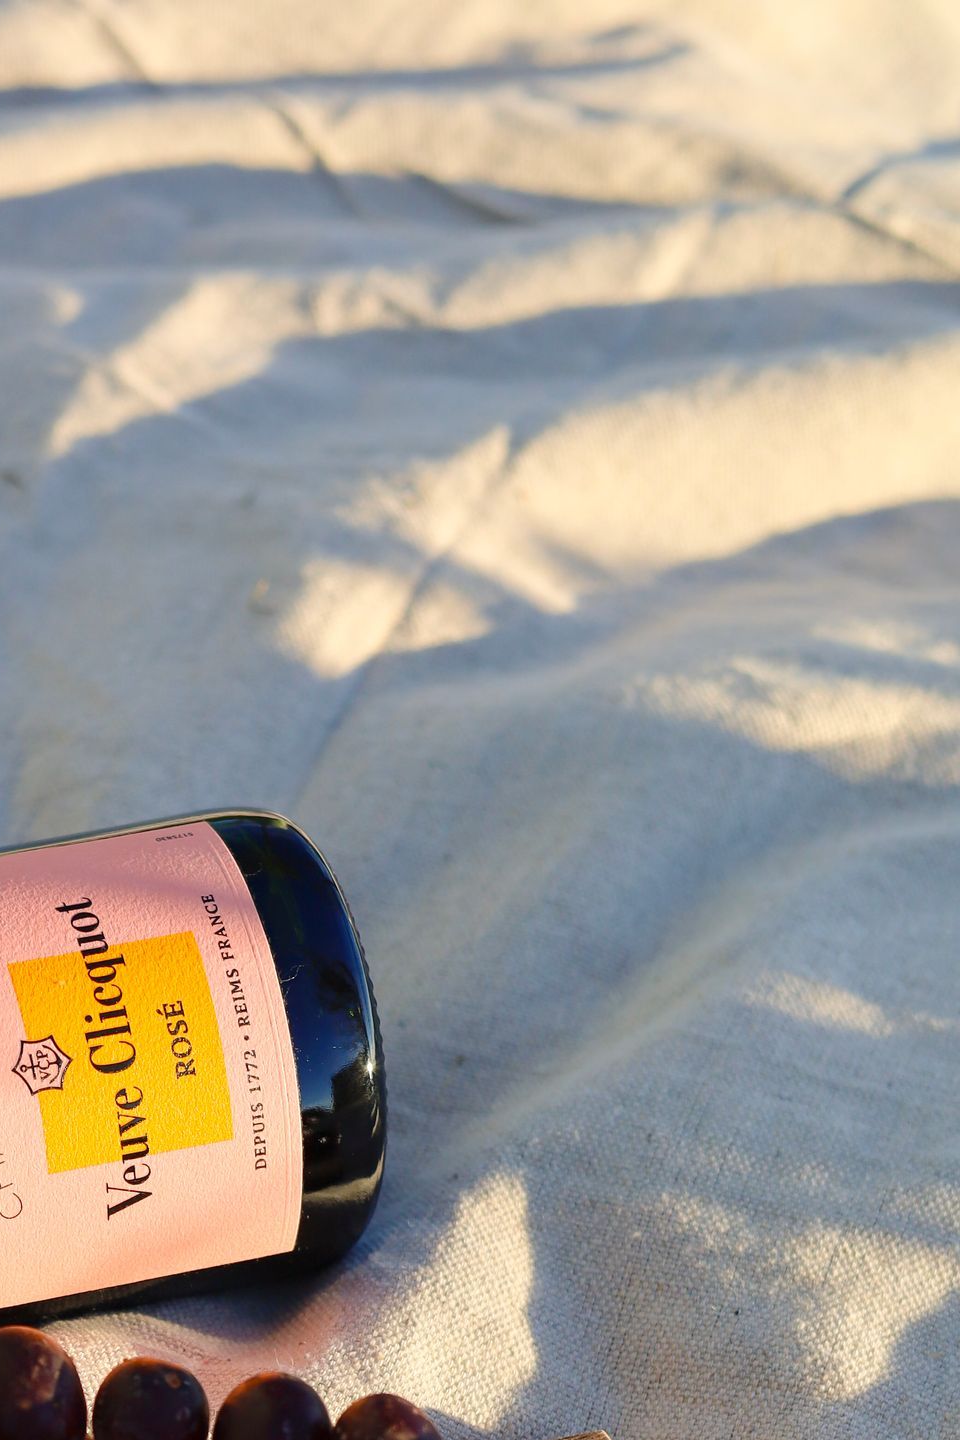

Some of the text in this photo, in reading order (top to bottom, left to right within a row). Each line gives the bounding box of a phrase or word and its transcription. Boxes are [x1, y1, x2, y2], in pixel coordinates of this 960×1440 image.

[55, 897, 152, 1220] Veuve Clicquot
[155, 1000, 196, 1079] ROSÉ
[201, 893, 267, 1170] DEPUIS 1772 REIMS FRANCE
